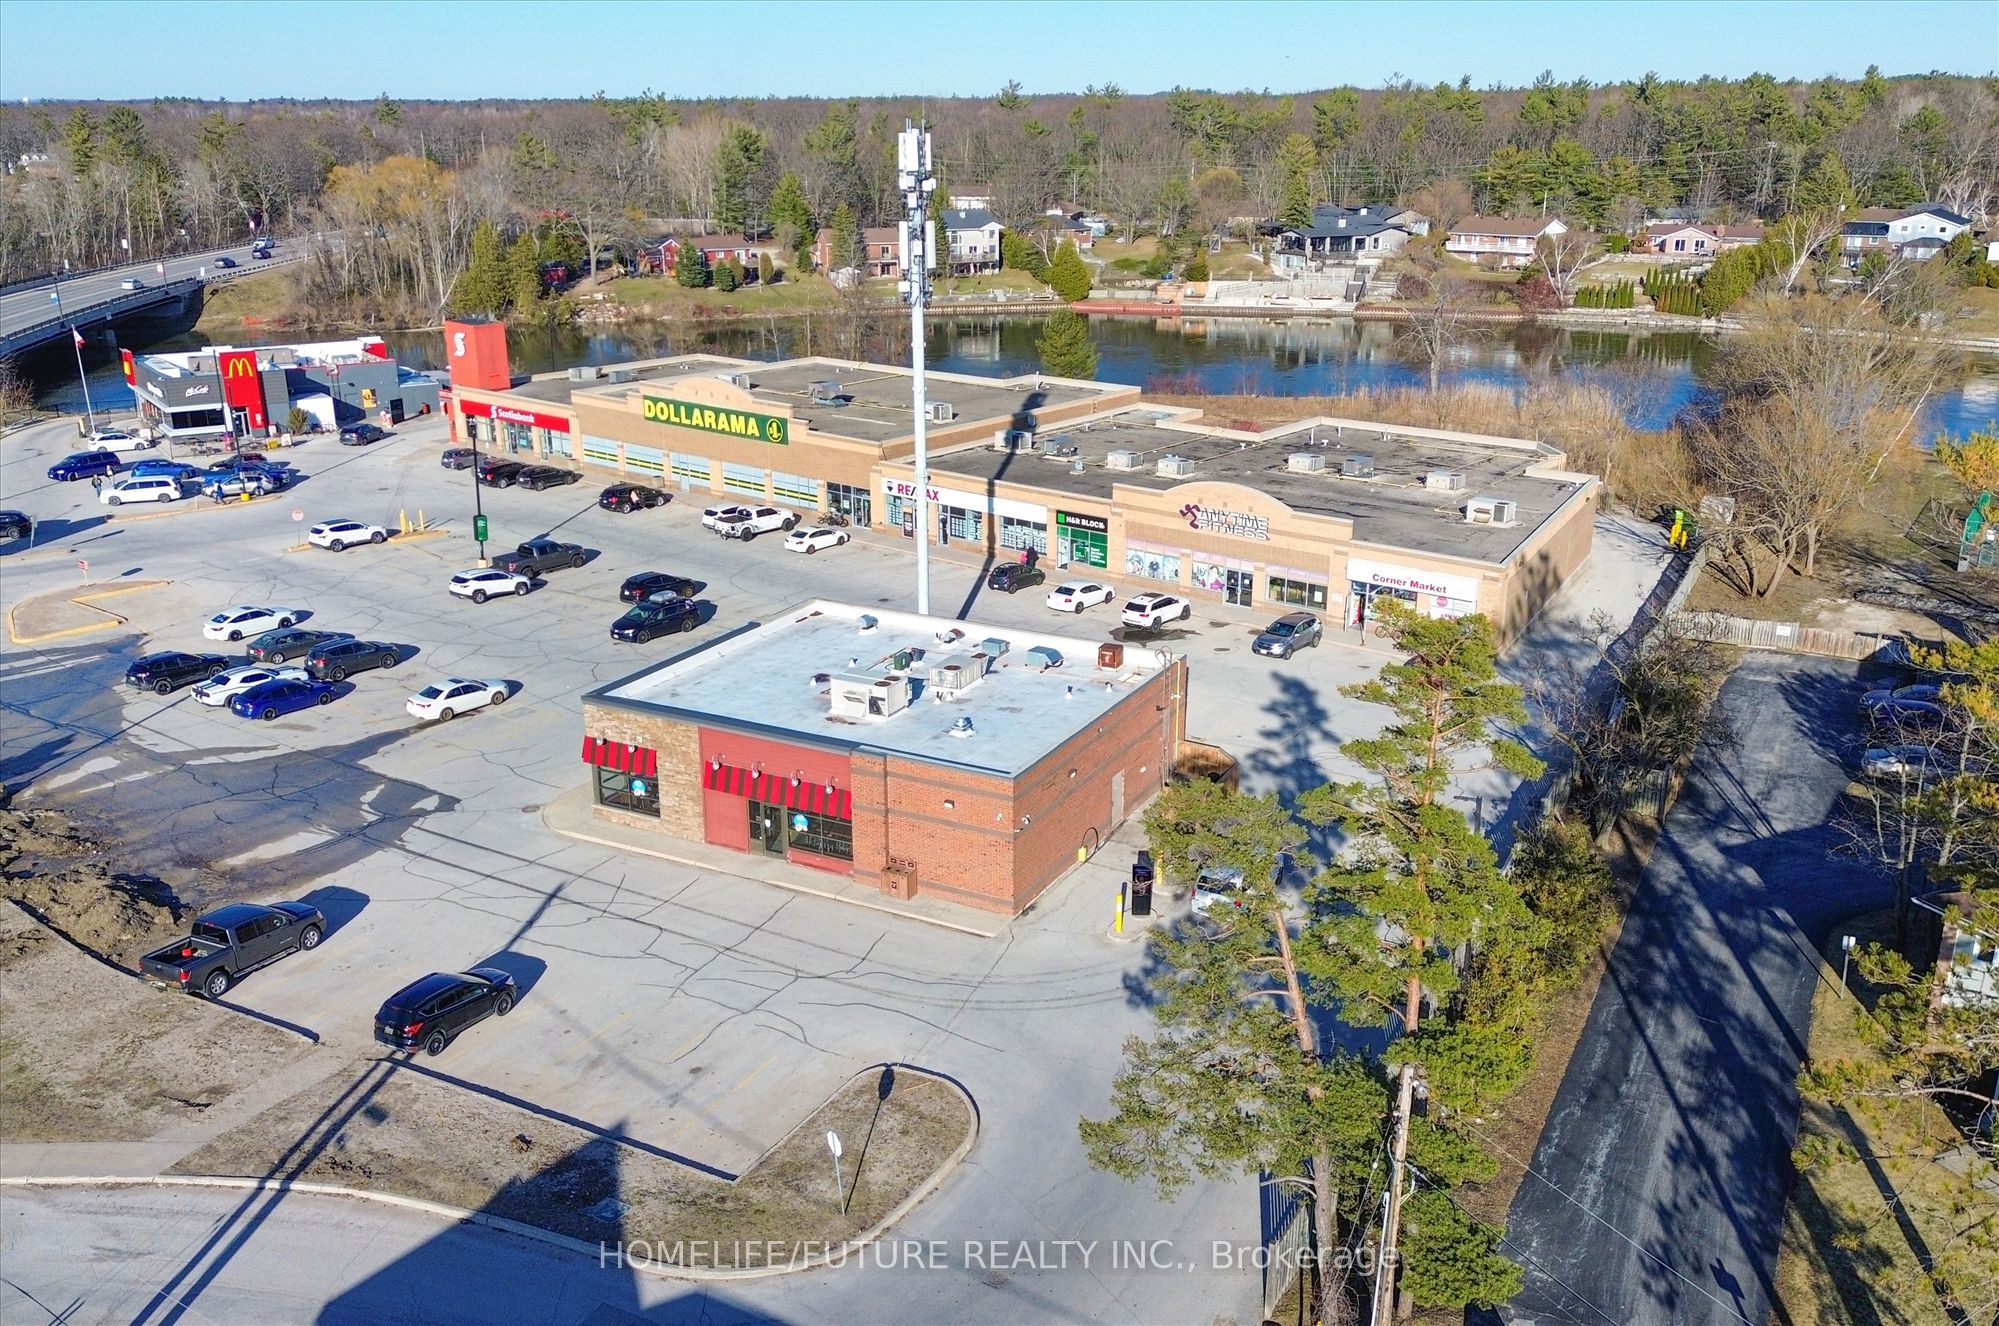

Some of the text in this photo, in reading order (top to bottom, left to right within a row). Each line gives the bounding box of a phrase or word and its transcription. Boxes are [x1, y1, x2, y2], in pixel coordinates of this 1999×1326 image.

[644, 400, 760, 437] DOLLARAMA
[897, 483, 939, 501] RE/AX
[1066, 516, 1080, 525] H&R
[1372, 573, 1447, 594] Corner Market
